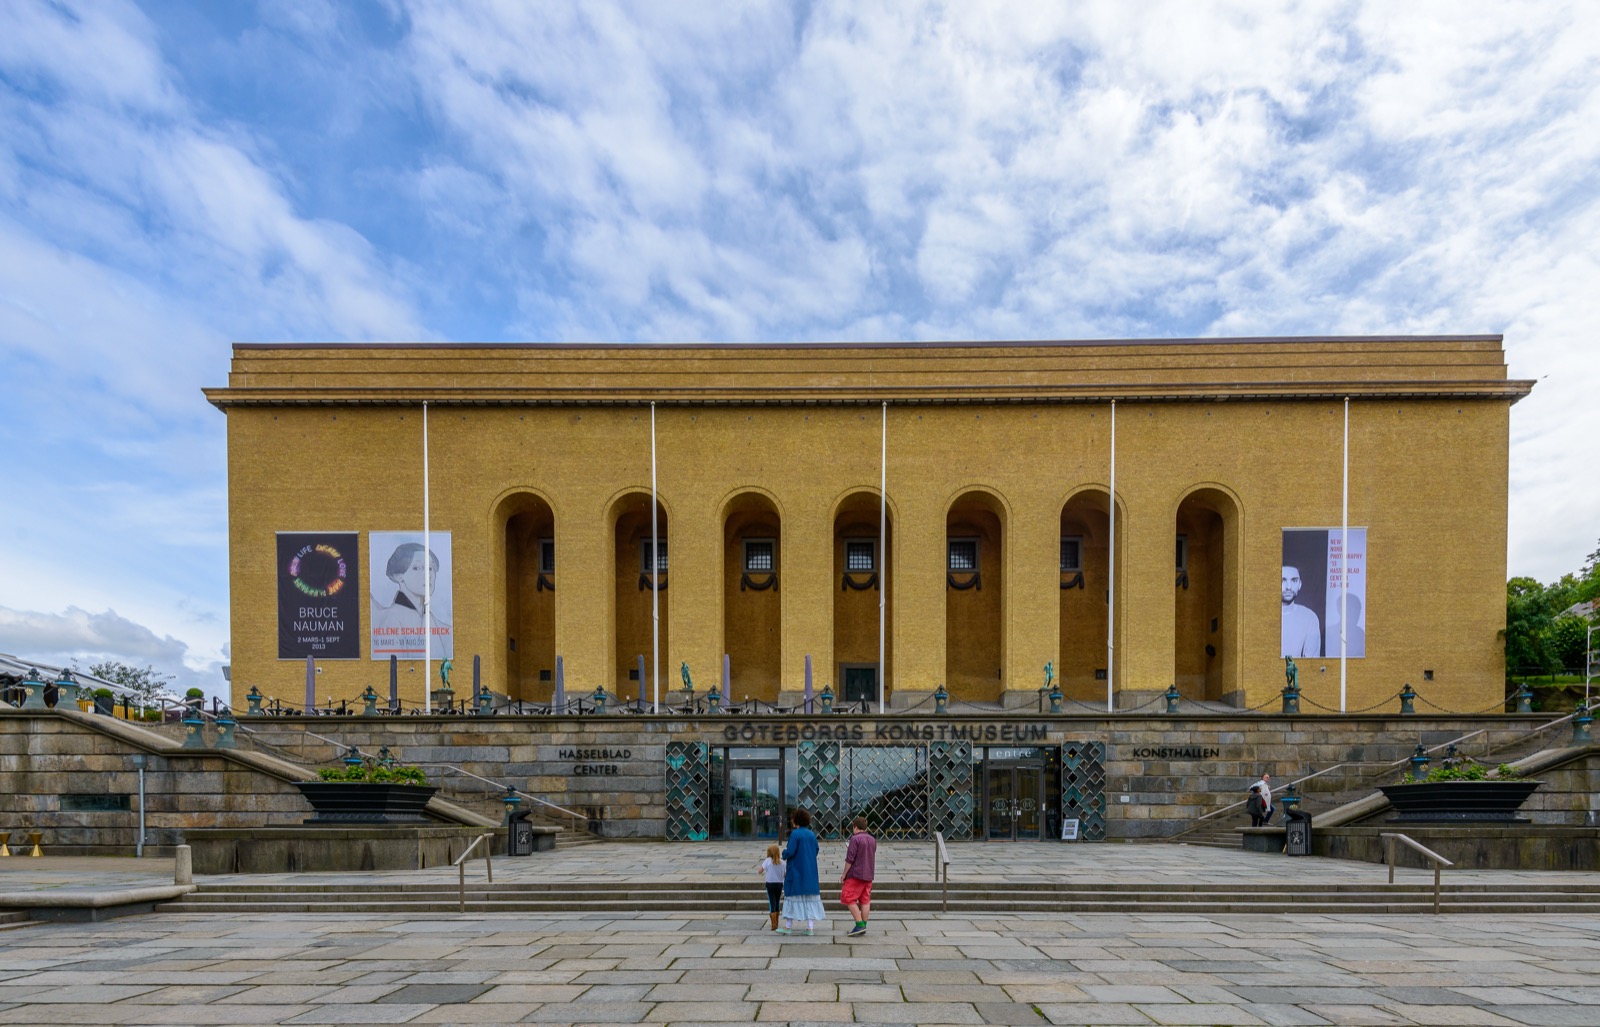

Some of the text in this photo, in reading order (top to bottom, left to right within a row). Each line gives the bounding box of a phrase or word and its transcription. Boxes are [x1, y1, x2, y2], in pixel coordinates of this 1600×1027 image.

[297, 545, 312, 557] LIFE
[299, 606, 338, 618] BRUCE
[293, 620, 344, 631] NAUMAN
[373, 627, 450, 636] HELENE SCHJEBECK
[724, 721, 1048, 741] GÖTEBORGS KONSTMUSEUM
[558, 749, 632, 759] HASSELBLAD
[1133, 747, 1220, 758] KONSTHALLEN
[573, 764, 618, 775] CENTER
